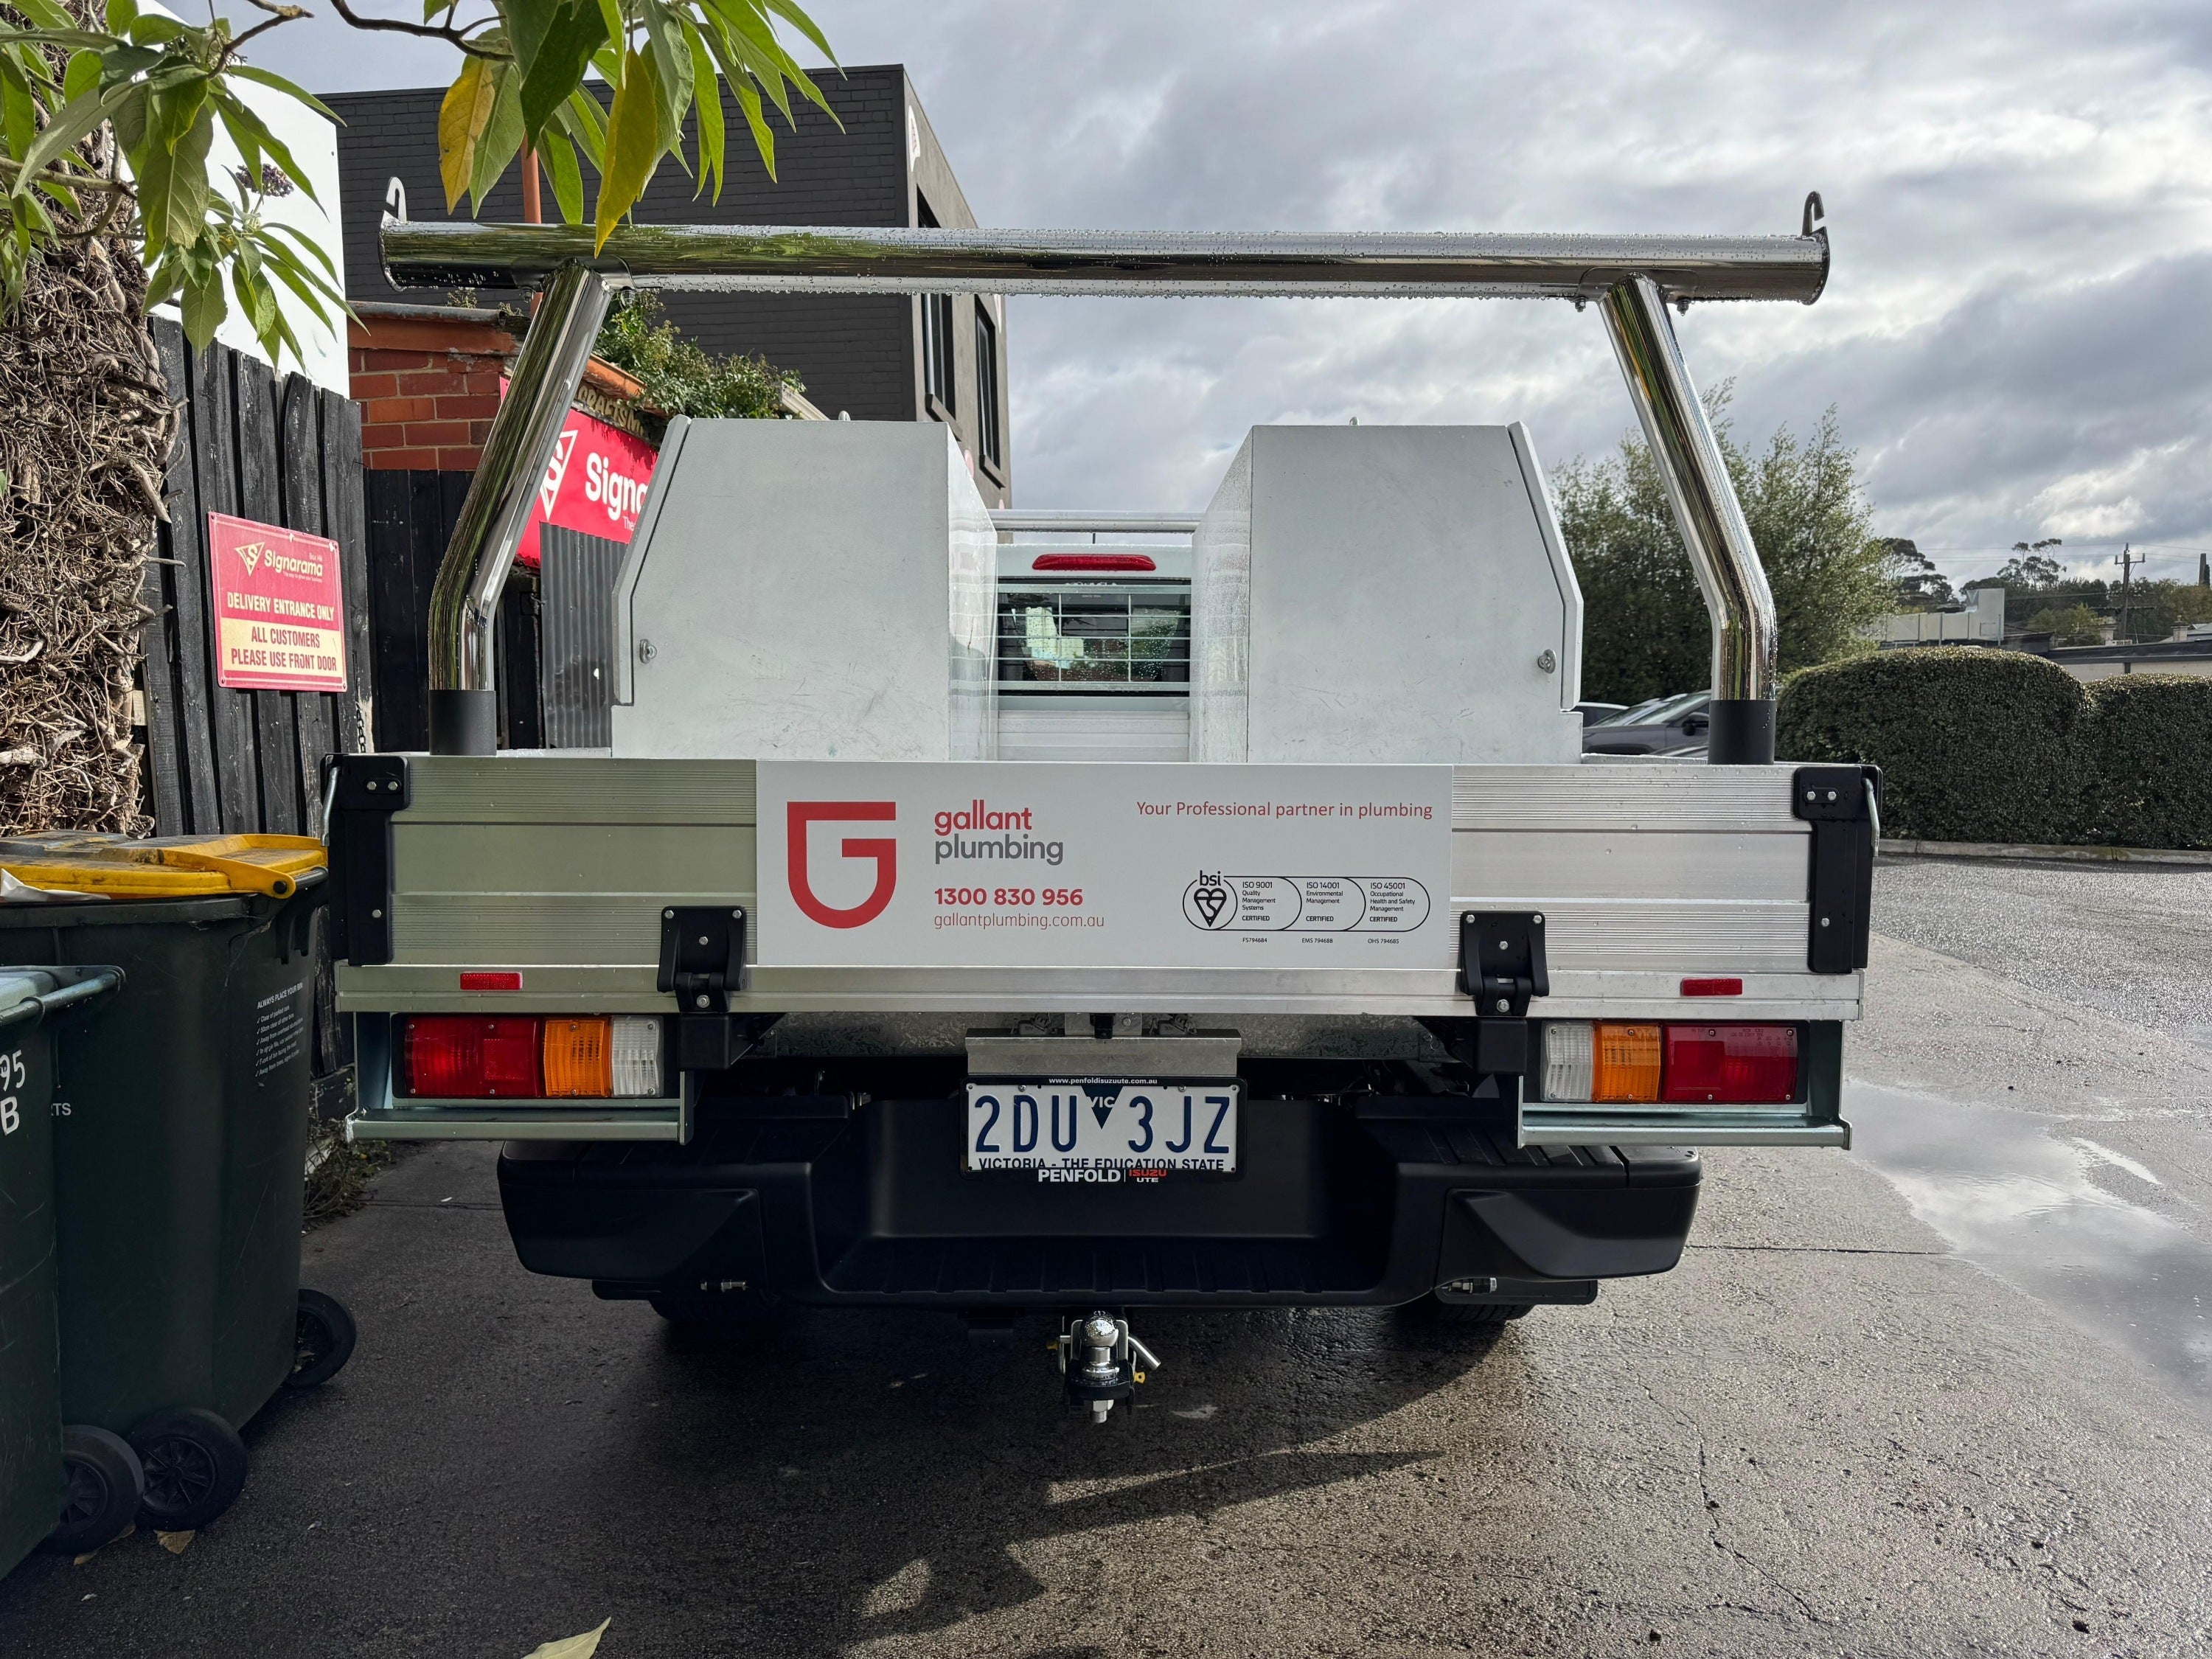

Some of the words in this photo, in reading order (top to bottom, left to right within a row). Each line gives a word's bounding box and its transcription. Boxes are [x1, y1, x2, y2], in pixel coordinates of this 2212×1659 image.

[264, 549, 323, 577] Signarama
[226, 591, 271, 613] DELIVERY
[274, 598, 316, 619] ENTRANCE
[316, 605, 335, 622] ONLY
[251, 626, 268, 643] ALL
[270, 628, 320, 648] CUSTOMERS
[231, 648, 267, 667] PLEASE
[269, 651, 287, 667] USE
[288, 653, 315, 669] FRONT
[317, 655, 337, 671] DOOR
[934, 799, 1032, 836] gallant
[1137, 801, 1170, 816] Your
[1177, 801, 1270, 816] Professional
[1276, 803, 1335, 819] partner
[1340, 802, 1353, 816] in
[1359, 801, 1433, 820] plumbing
[935, 833, 1063, 866] plumbing
[1199, 869, 1222, 886] bsi
[934, 888, 987, 905] 1300
[994, 888, 1035, 906] 830
[1042, 888, 1083, 906] 956
[934, 912, 1105, 930] gallantplumbing.com.au
[257, 995, 274, 1009] ALWAYS
[275, 990, 287, 1001] PLACE
[288, 984, 296, 995] YOUR
[51, 1102, 72, 1116] TS
[1087, 1096, 1116, 1108] VIC
[0, 1096, 20, 1135] B
[975, 1094, 1077, 1152] 2DU
[1128, 1095, 1230, 1154] 3JZ
[978, 1158, 1046, 1169] VICTORIA
[1062, 1158, 1089, 1168] THE
[1095, 1158, 1177, 1169] EDUCATION
[1182, 1159, 1224, 1170] STATE
[1037, 1169, 1121, 1183] PENFOLD
